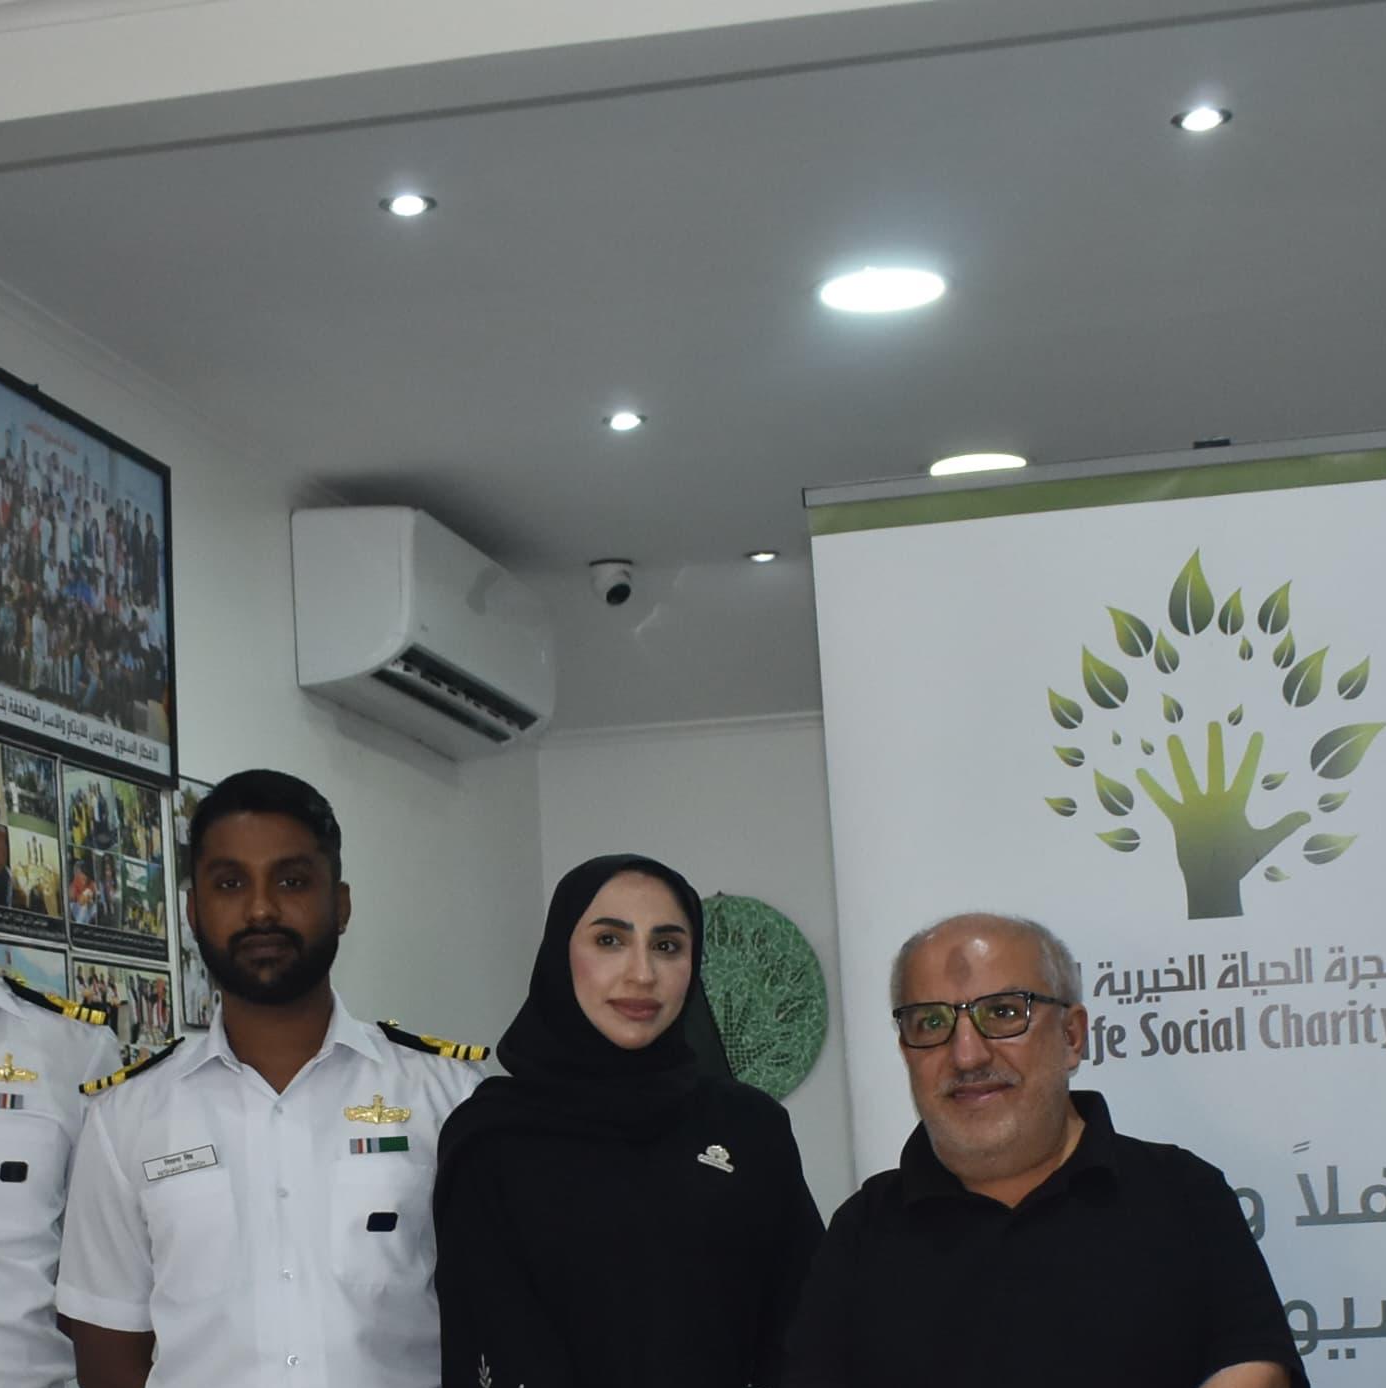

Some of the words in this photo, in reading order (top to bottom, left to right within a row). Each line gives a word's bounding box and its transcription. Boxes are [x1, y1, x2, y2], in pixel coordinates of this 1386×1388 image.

[1093, 953, 1207, 1005] الخيرية
[1216, 946, 1313, 996] الحياة
[1140, 1006, 1246, 1058] Social
